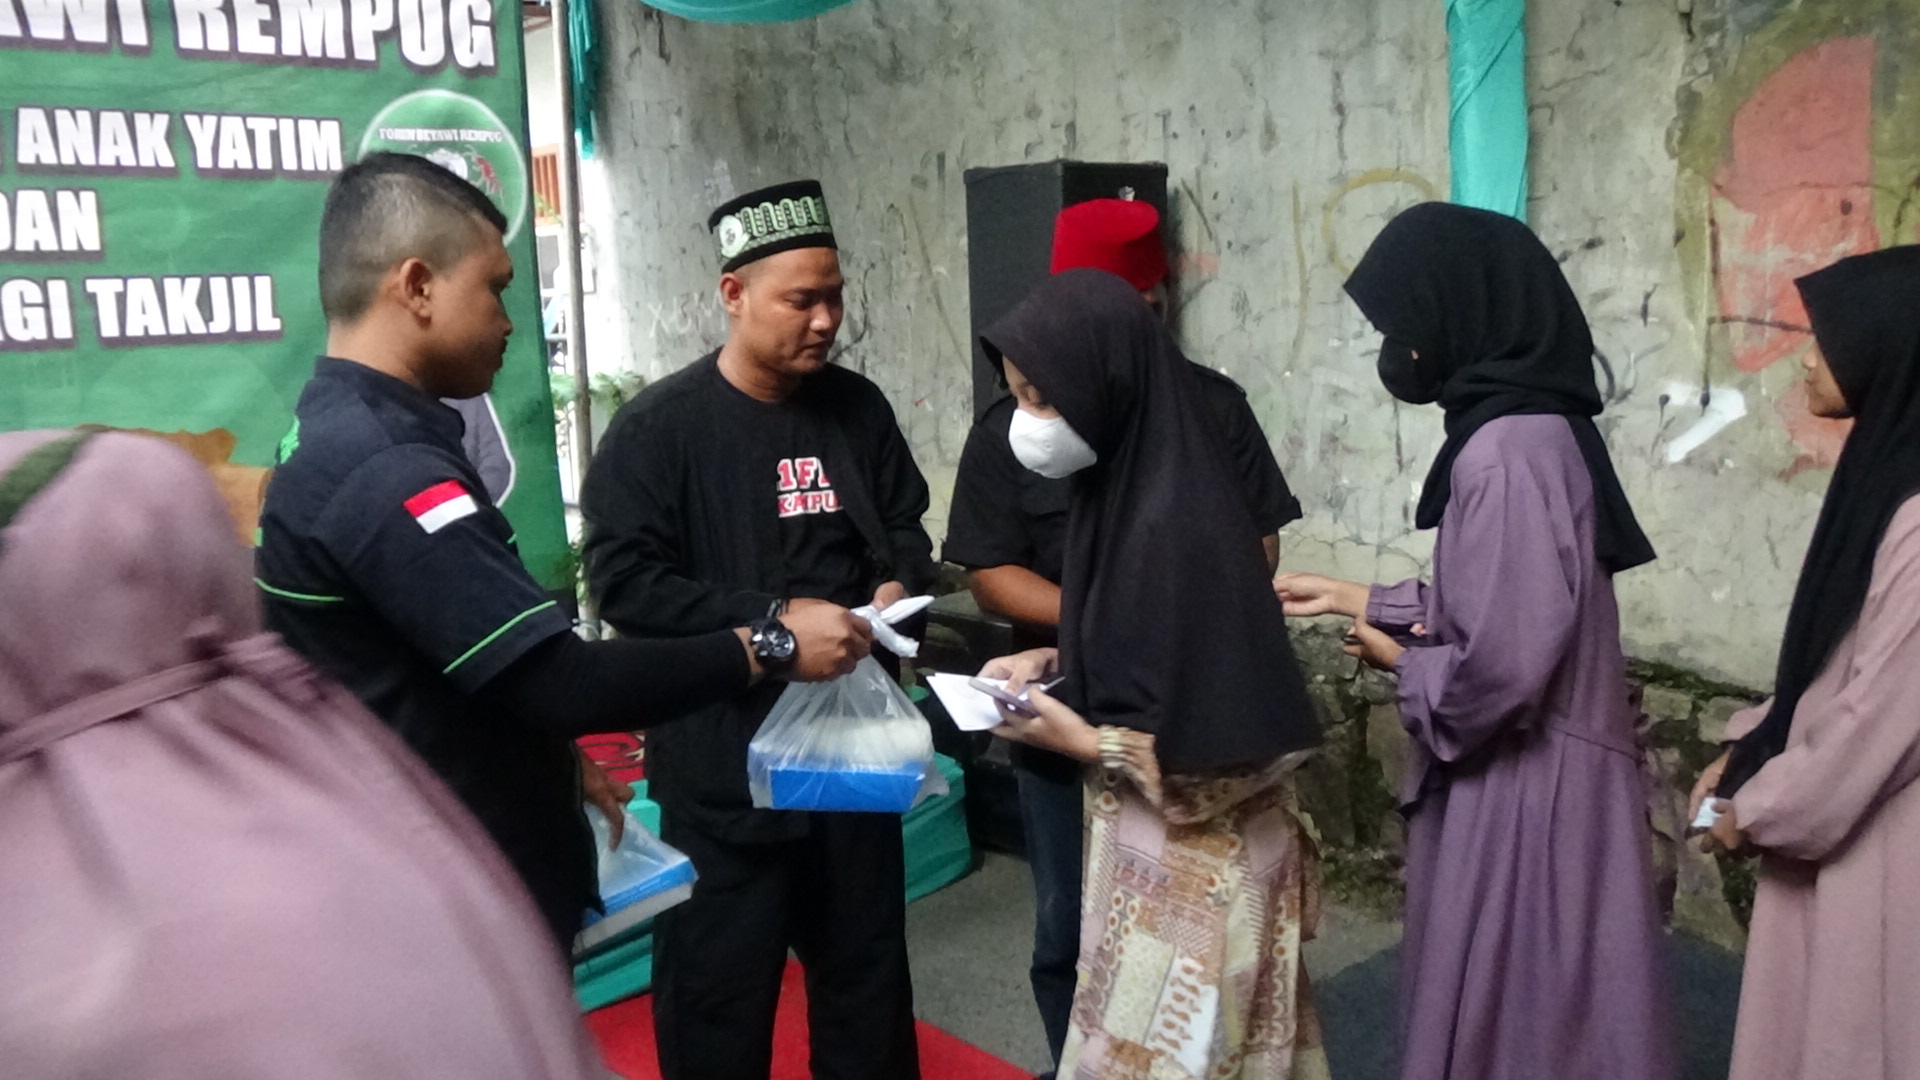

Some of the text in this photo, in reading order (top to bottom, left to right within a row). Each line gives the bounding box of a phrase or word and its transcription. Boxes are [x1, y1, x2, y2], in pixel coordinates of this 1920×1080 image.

[173, 0, 495, 68] REMPUG
[16, 106, 343, 171] ANAK YATIM
[0, 275, 282, 342] GI TAKJIL
